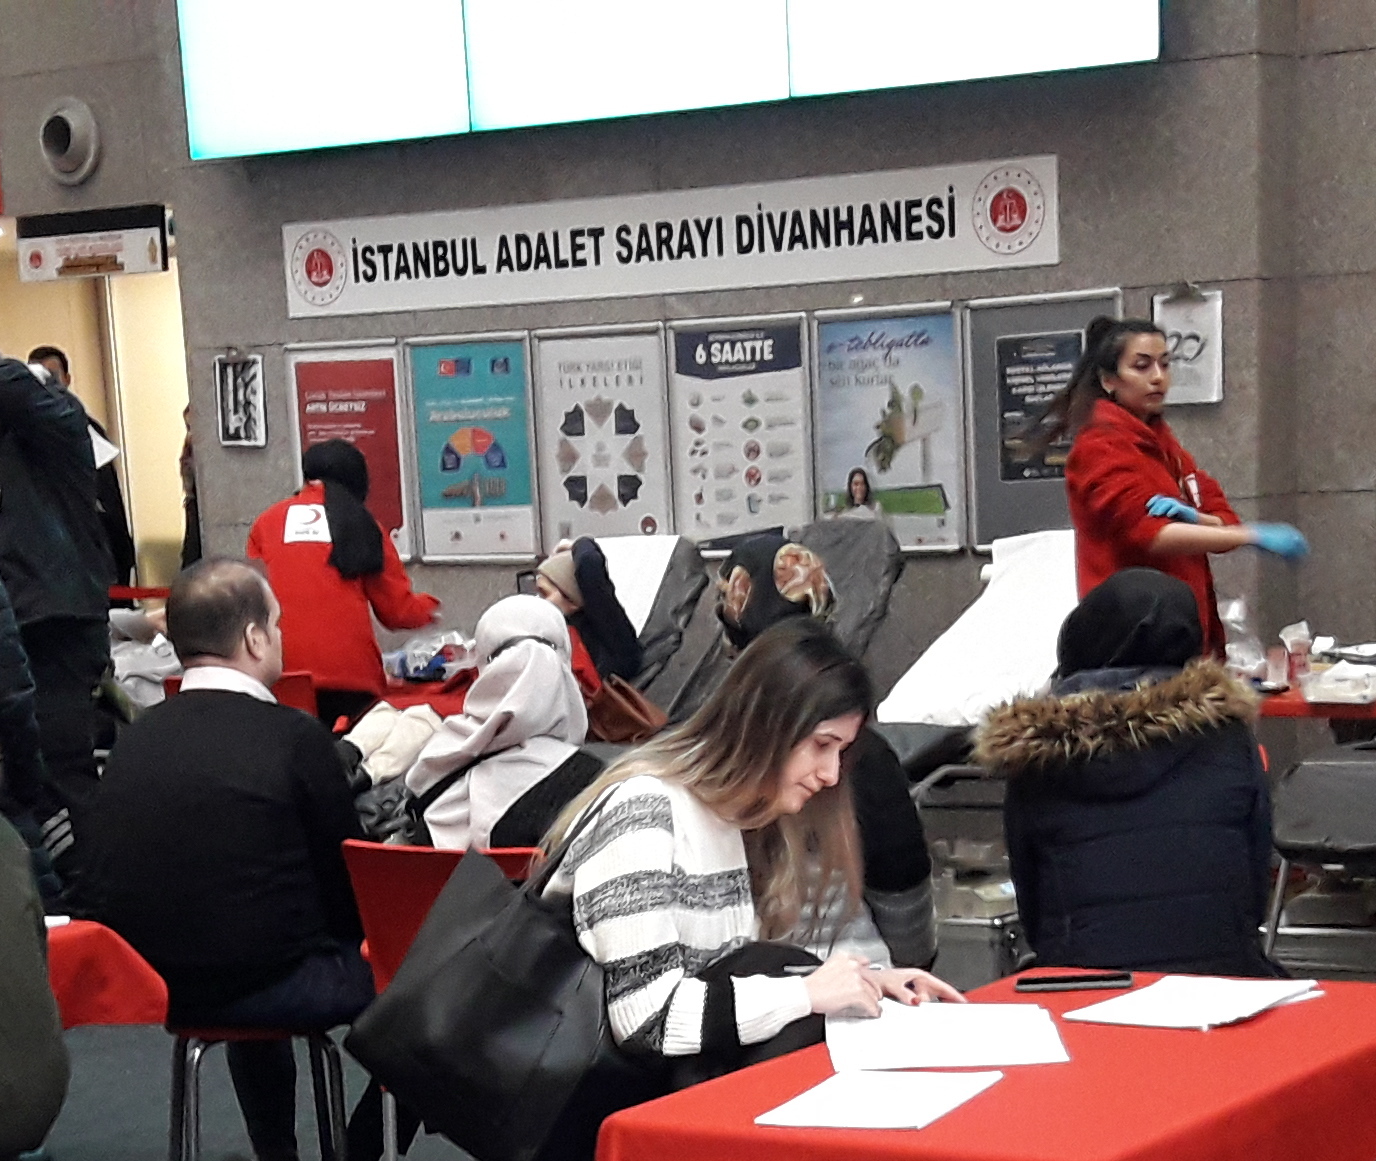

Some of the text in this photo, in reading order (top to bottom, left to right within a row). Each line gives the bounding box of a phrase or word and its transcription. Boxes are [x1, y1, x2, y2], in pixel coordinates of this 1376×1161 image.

[351, 184, 957, 284] İSTANBUL ADALET SARAYI DİVANHANESİ
[695, 338, 775, 365] 6 SAATTE
